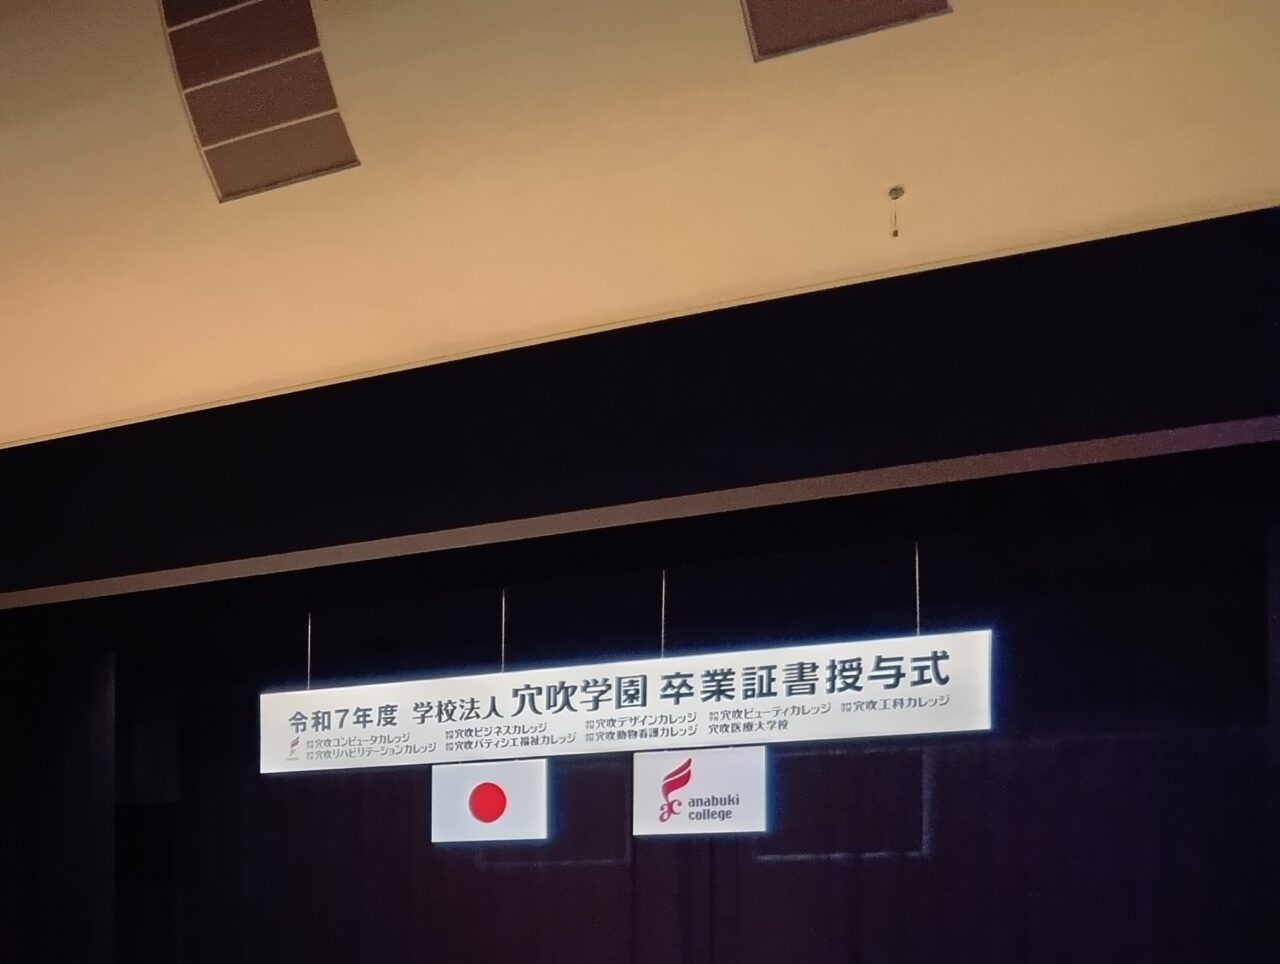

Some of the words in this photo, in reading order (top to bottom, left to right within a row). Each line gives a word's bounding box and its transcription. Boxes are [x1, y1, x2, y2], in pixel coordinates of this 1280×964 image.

[288, 704, 398, 734] 令和7年度
[412, 697, 504, 724] 学校法人
[511, 675, 647, 715] 穴吹学園
[660, 650, 950, 704] 卒業証書授与式
[852, 695, 951, 713] 穴吹工科カレッジ
[596, 712, 697, 729] 穴吹デザインカレッジ
[455, 722, 548, 739] 穴吹ビジネスカレッジ
[688, 794, 740, 807] anabuki
[688, 809, 732, 821] college
